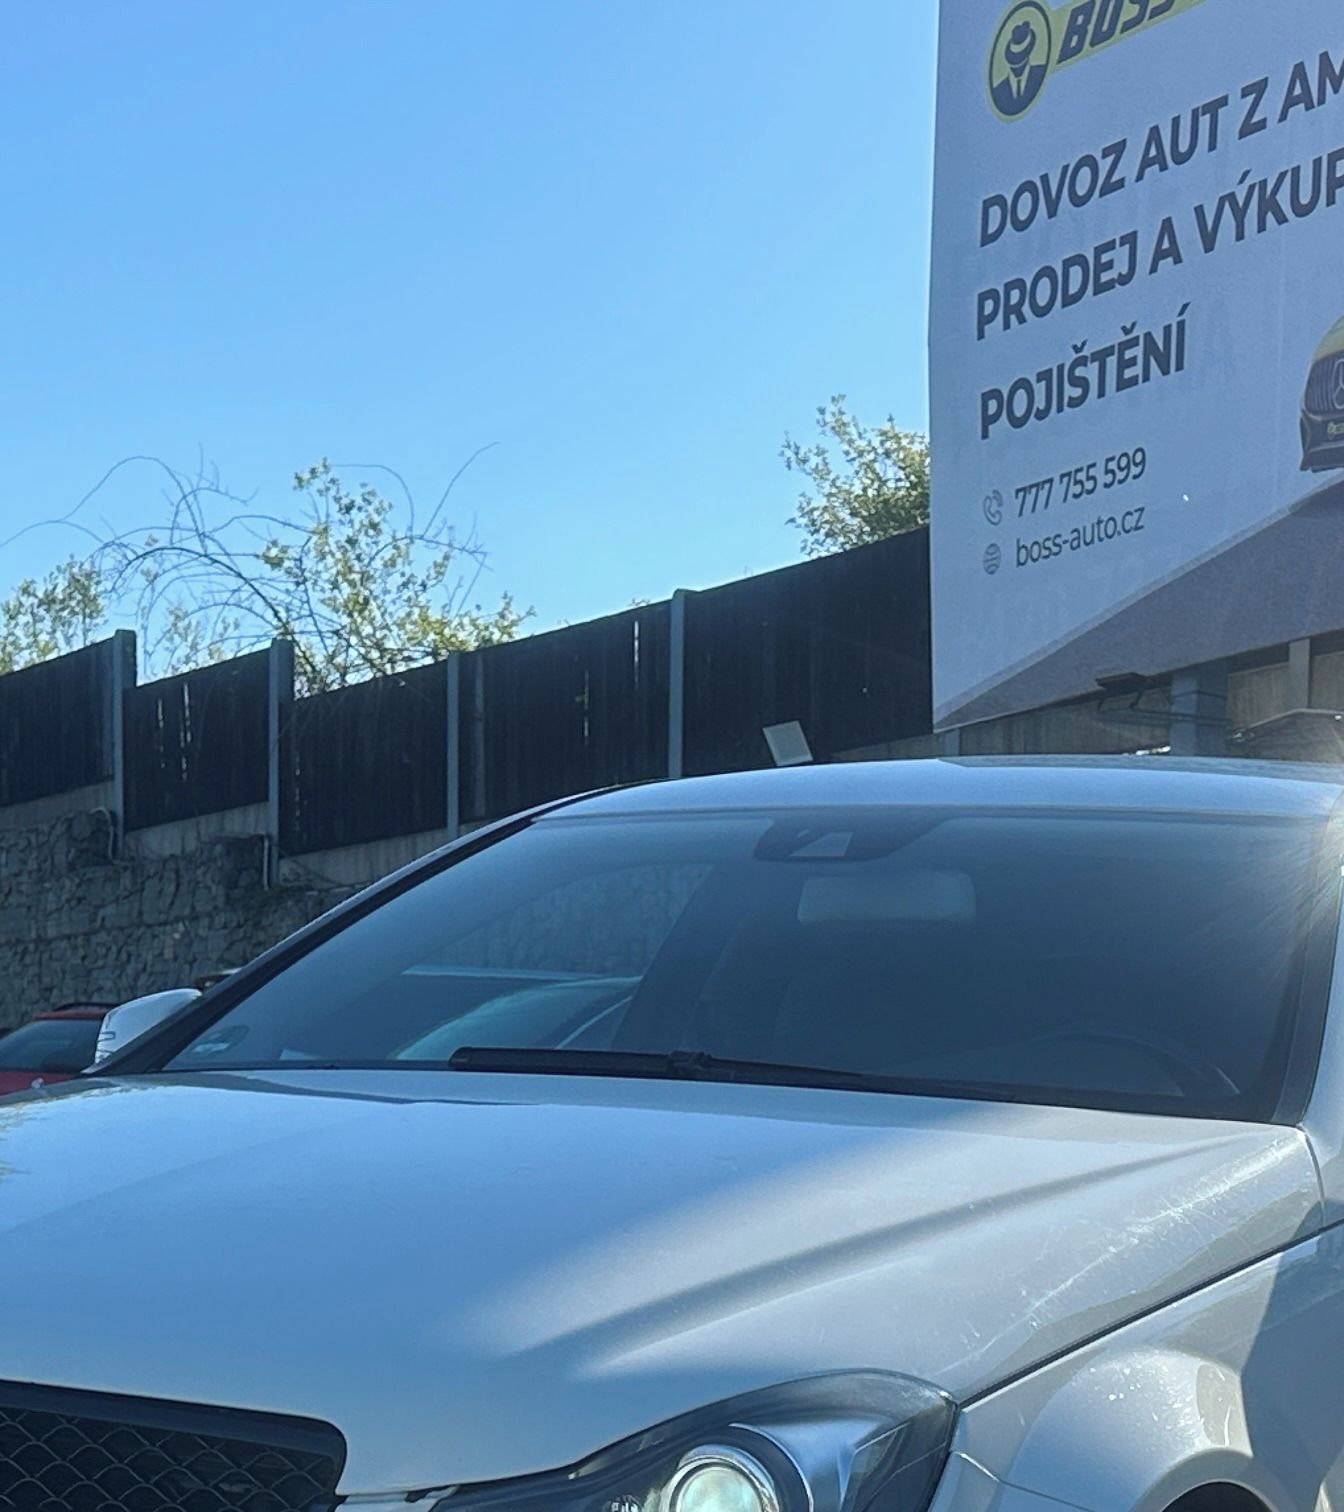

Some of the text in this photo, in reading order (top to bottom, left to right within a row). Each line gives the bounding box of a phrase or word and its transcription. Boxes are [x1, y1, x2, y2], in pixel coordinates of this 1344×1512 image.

[979, 138, 1127, 248] DOVOZ
[1135, 94, 1229, 183] AUT
[1238, 76, 1269, 140] Z
[977, 230, 1138, 340] PRODEJ
[1149, 216, 1183, 275] A
[981, 302, 1191, 440] POJIŠTĚNÍ
[1015, 447, 1146, 517] 777 755 599
[1016, 506, 1145, 568] boss-auto.cz
